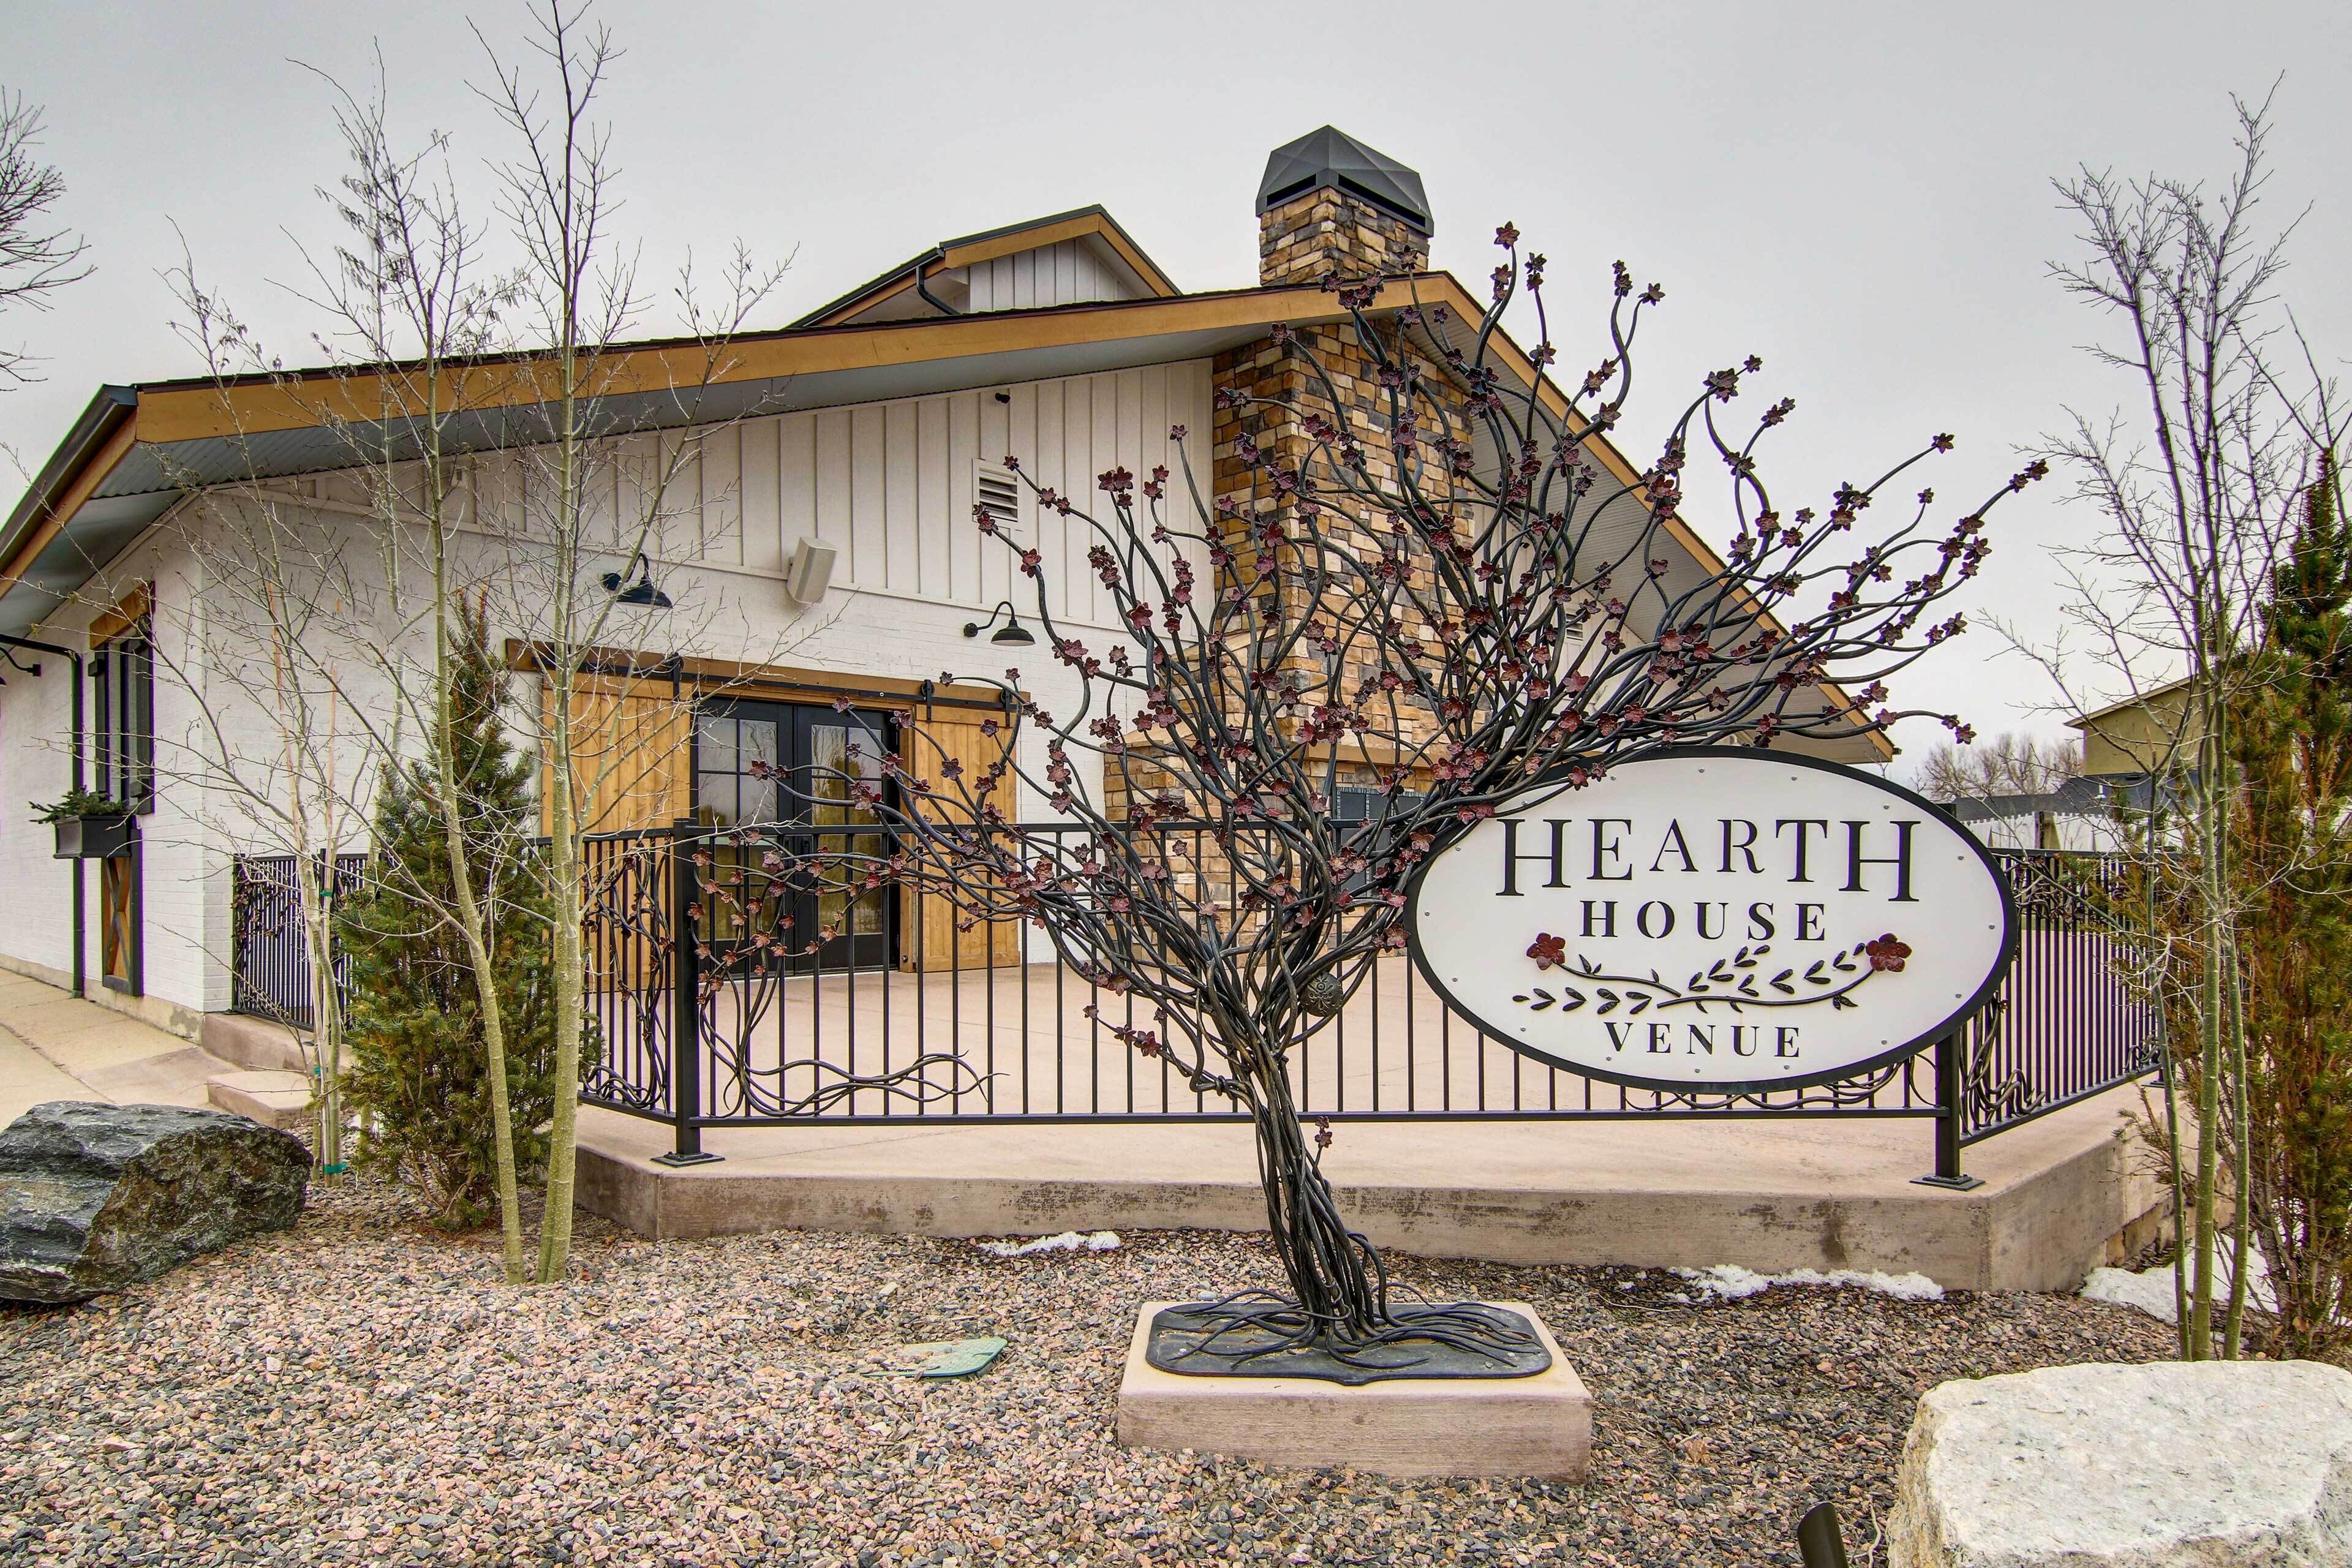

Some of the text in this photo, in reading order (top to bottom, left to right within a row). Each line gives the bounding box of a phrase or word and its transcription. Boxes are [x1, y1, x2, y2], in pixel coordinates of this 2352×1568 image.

[1496, 818, 1921, 902] HEARTH
[1580, 900, 1826, 941] HOUSE
[1604, 1022, 1801, 1058] VENUE
